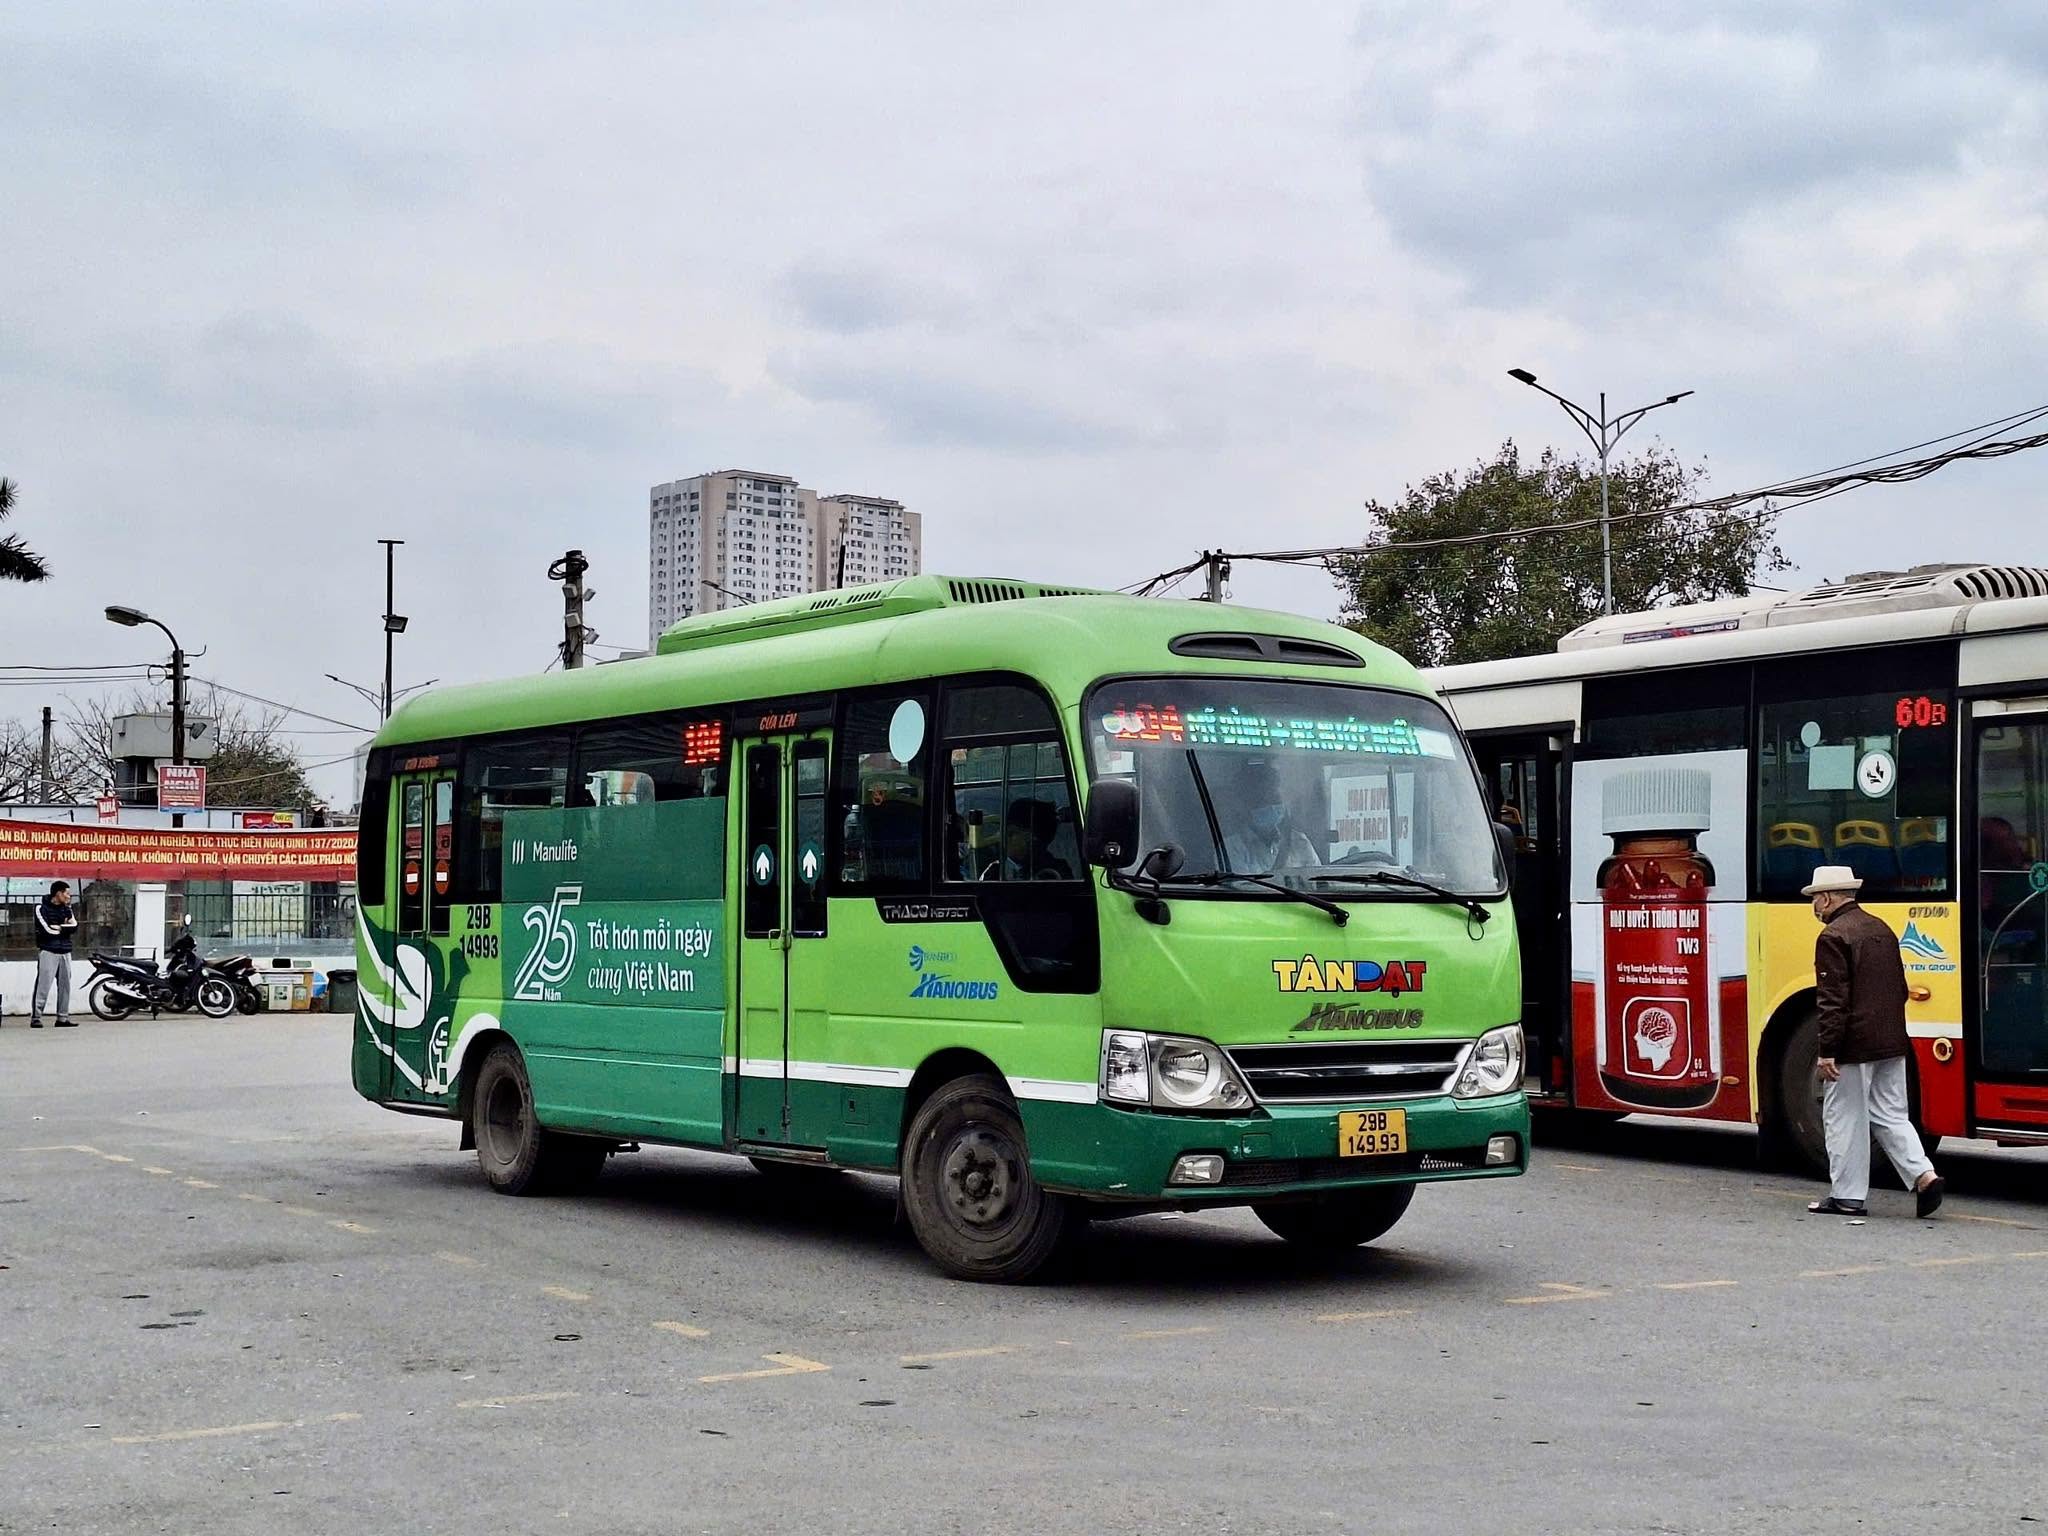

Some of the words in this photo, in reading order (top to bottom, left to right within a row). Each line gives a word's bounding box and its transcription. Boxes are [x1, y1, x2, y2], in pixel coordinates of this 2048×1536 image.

[107, 833, 139, 846] HOÀNG
[141, 835, 158, 847] MAI
[533, 839, 578, 862] Manulife
[0, 847, 33, 861] KHÔNG
[58, 848, 90, 863] KHÔNG
[142, 850, 174, 864] KHÔNG
[279, 852, 297, 865] CÁC
[466, 905, 492, 929] 29B
[883, 904, 929, 919] THACO
[459, 934, 499, 959] 14993
[514, 881, 584, 1001] 25
[587, 918, 609, 950] Tốt
[612, 921, 639, 950] hơn
[643, 917, 671, 950] mỗi
[675, 920, 713, 958] ngày
[1676, 937, 1699, 954] TW3
[588, 958, 623, 995] cùng
[625, 961, 654, 996] Việt
[657, 961, 694, 992] Nam
[909, 973, 998, 1000] HANOIBUS
[1289, 1002, 1425, 1032] HANOIBUS
[1358, 1112, 1388, 1133] 29B
[1349, 1133, 1401, 1155] 149.93
